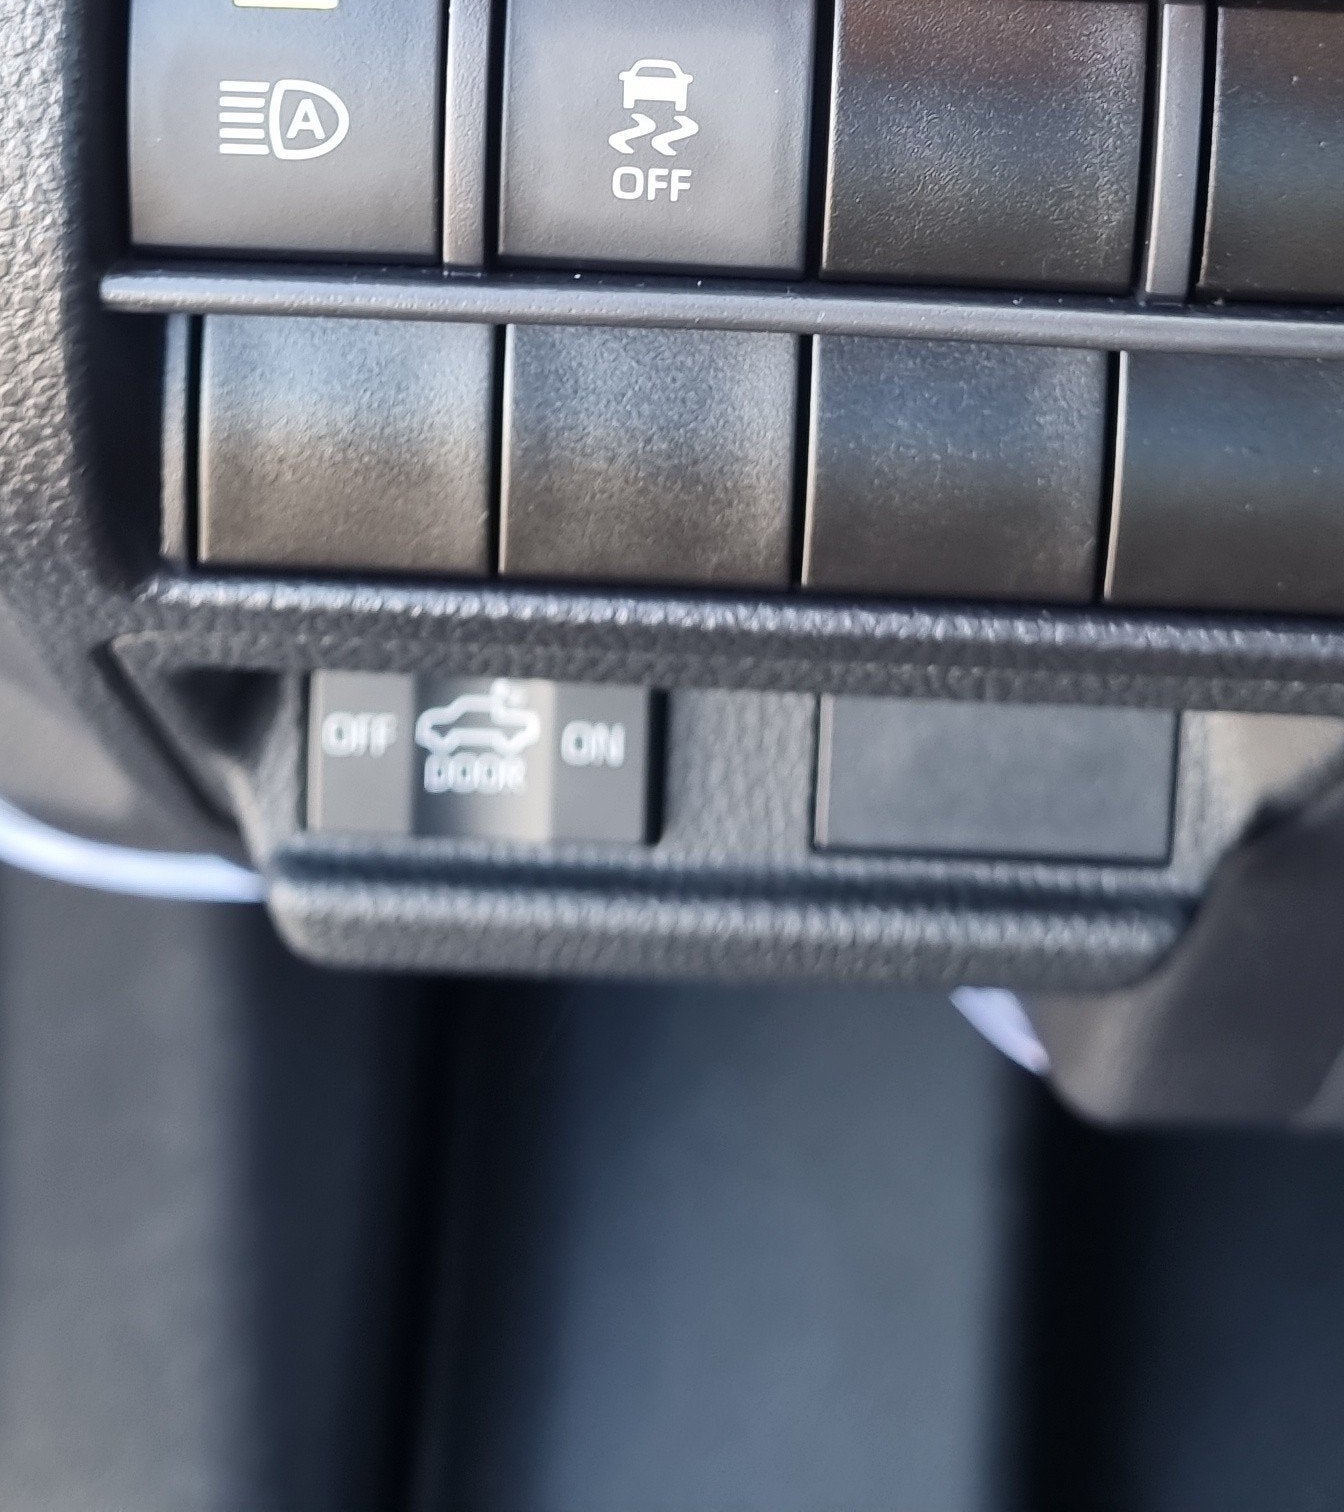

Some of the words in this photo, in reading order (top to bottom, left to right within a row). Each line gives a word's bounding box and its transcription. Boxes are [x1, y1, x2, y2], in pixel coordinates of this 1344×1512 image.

[286, 98, 326, 140] A
[611, 165, 693, 202] OFF
[322, 710, 397, 757] OFF
[560, 720, 625, 768] ON
